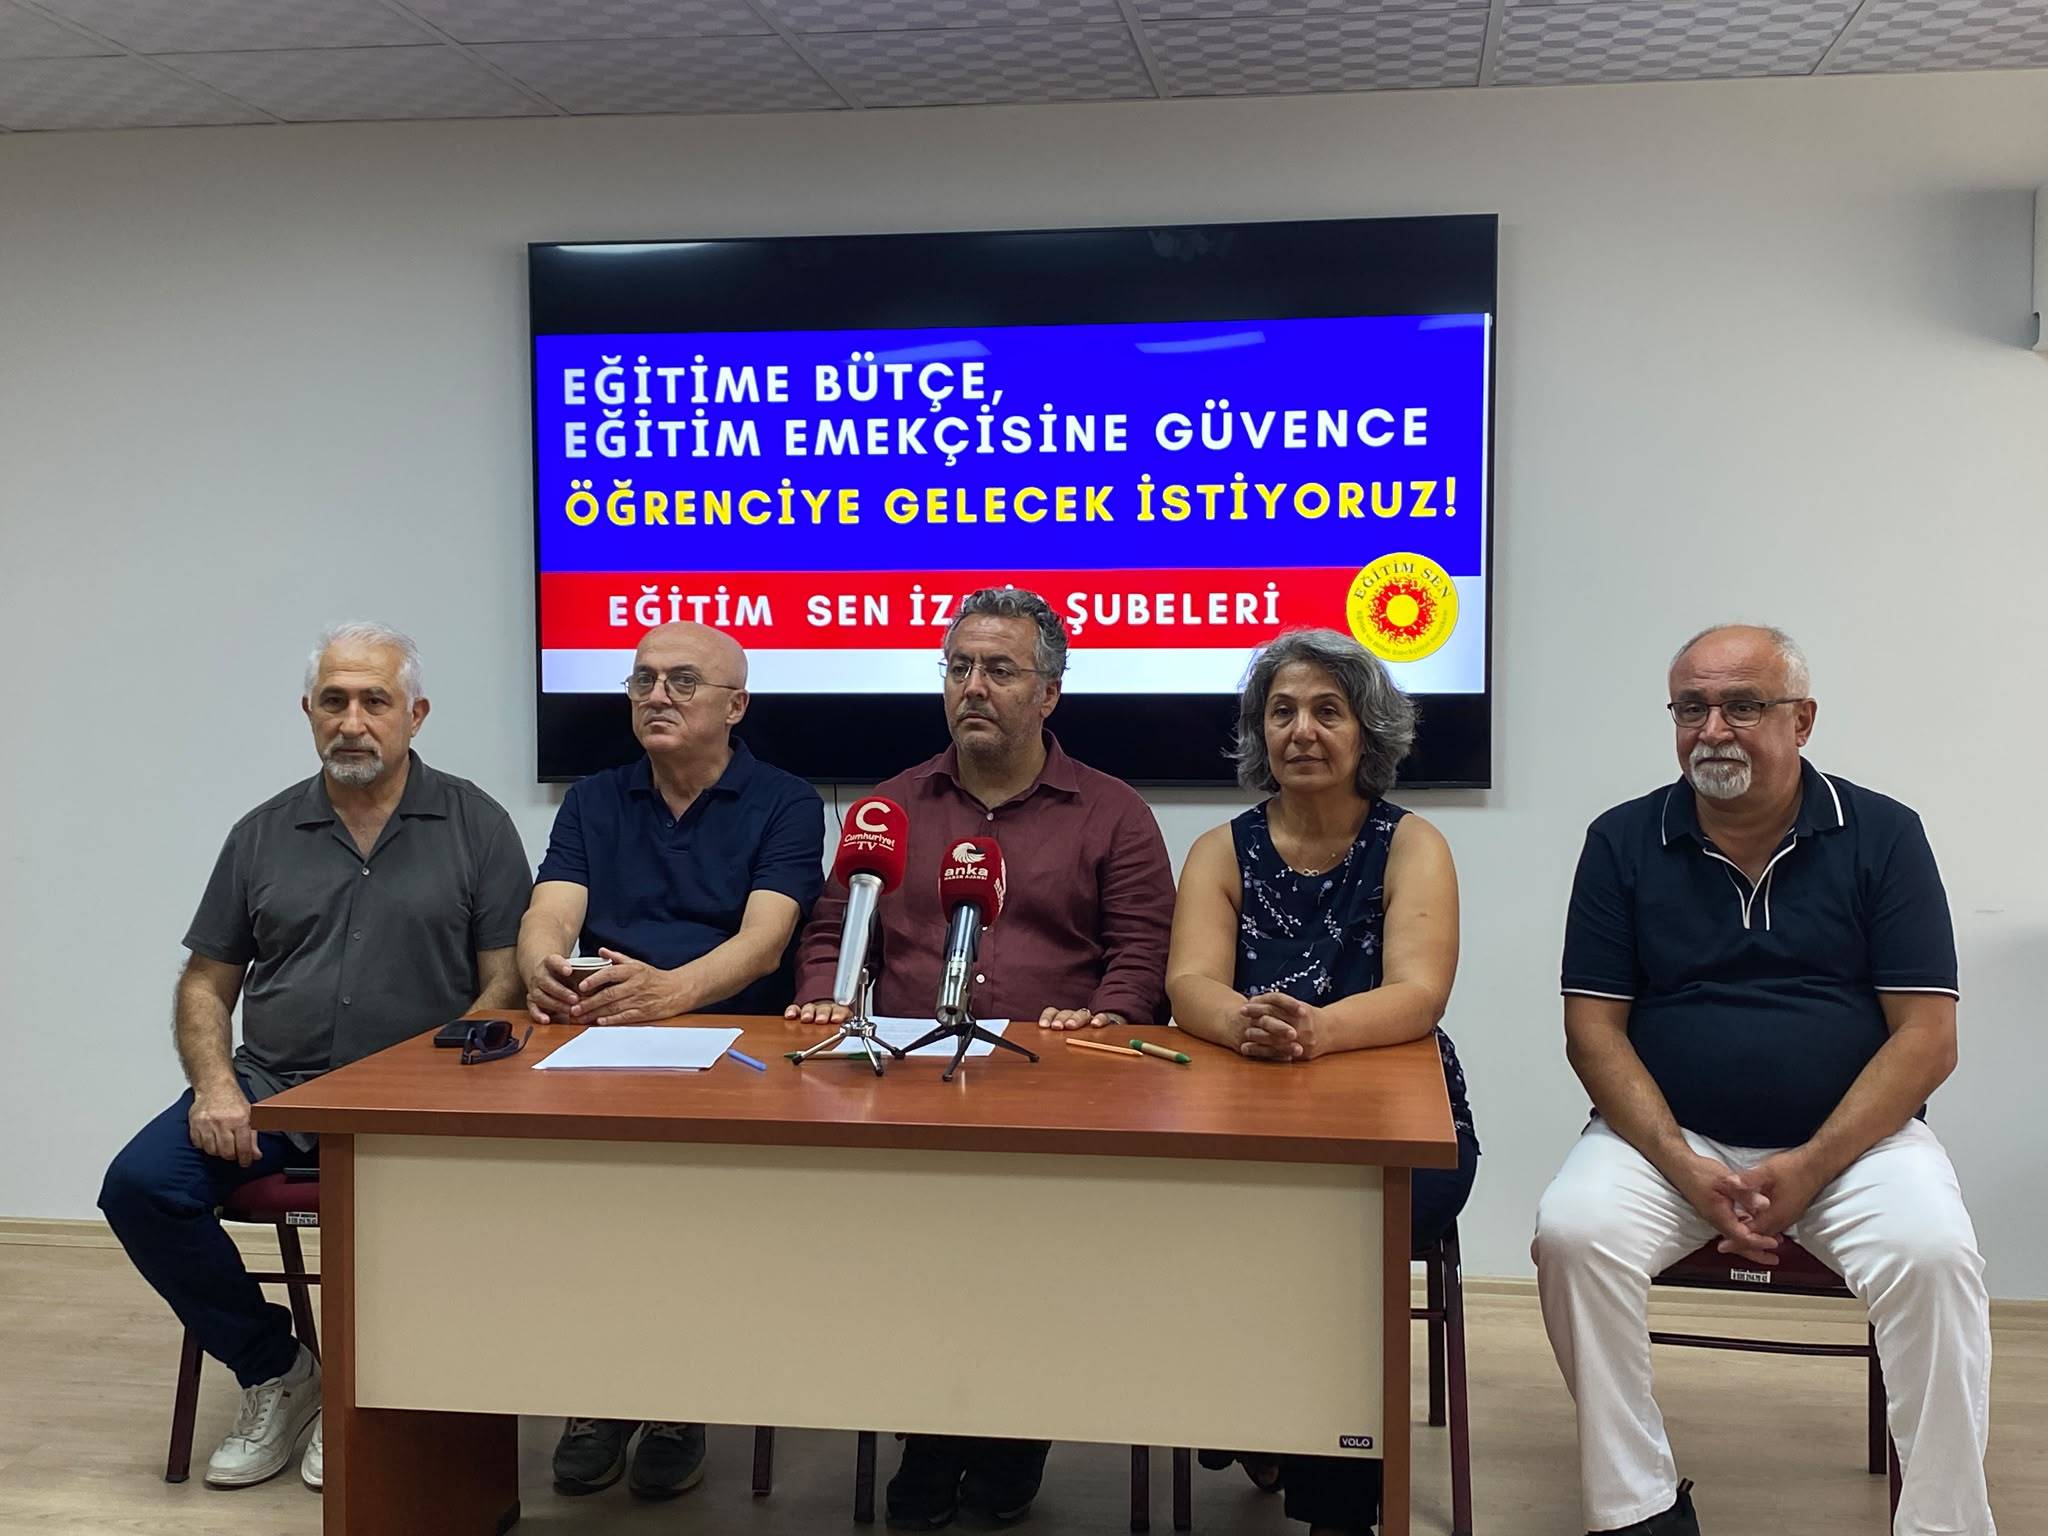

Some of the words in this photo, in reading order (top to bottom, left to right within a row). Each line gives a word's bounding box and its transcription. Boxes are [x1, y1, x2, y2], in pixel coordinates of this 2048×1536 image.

[564, 355, 788, 405] EĞİTİME
[815, 352, 1004, 412] BÜTÇE,
[564, 408, 760, 459] EĞİTİM
[785, 402, 1127, 466] EMEKÇİSİNE
[1155, 399, 1427, 451] GÜVENCE
[565, 478, 860, 526] ÖĞRENCİYE
[884, 485, 1114, 524] GELECEK
[1136, 471, 1457, 521] İSTİYORUZ!
[1354, 560, 1415, 600] EĞİTİM
[1422, 567, 1452, 599] SEN
[609, 585, 773, 627] EĞİTİM
[806, 594, 889, 627] SEN
[1066, 582, 1280, 635] ŞUBELERİ
[855, 801, 891, 833] C
[857, 841, 878, 851] TV
[944, 863, 988, 877] anka
[1342, 1437, 1370, 1447] YOLO
